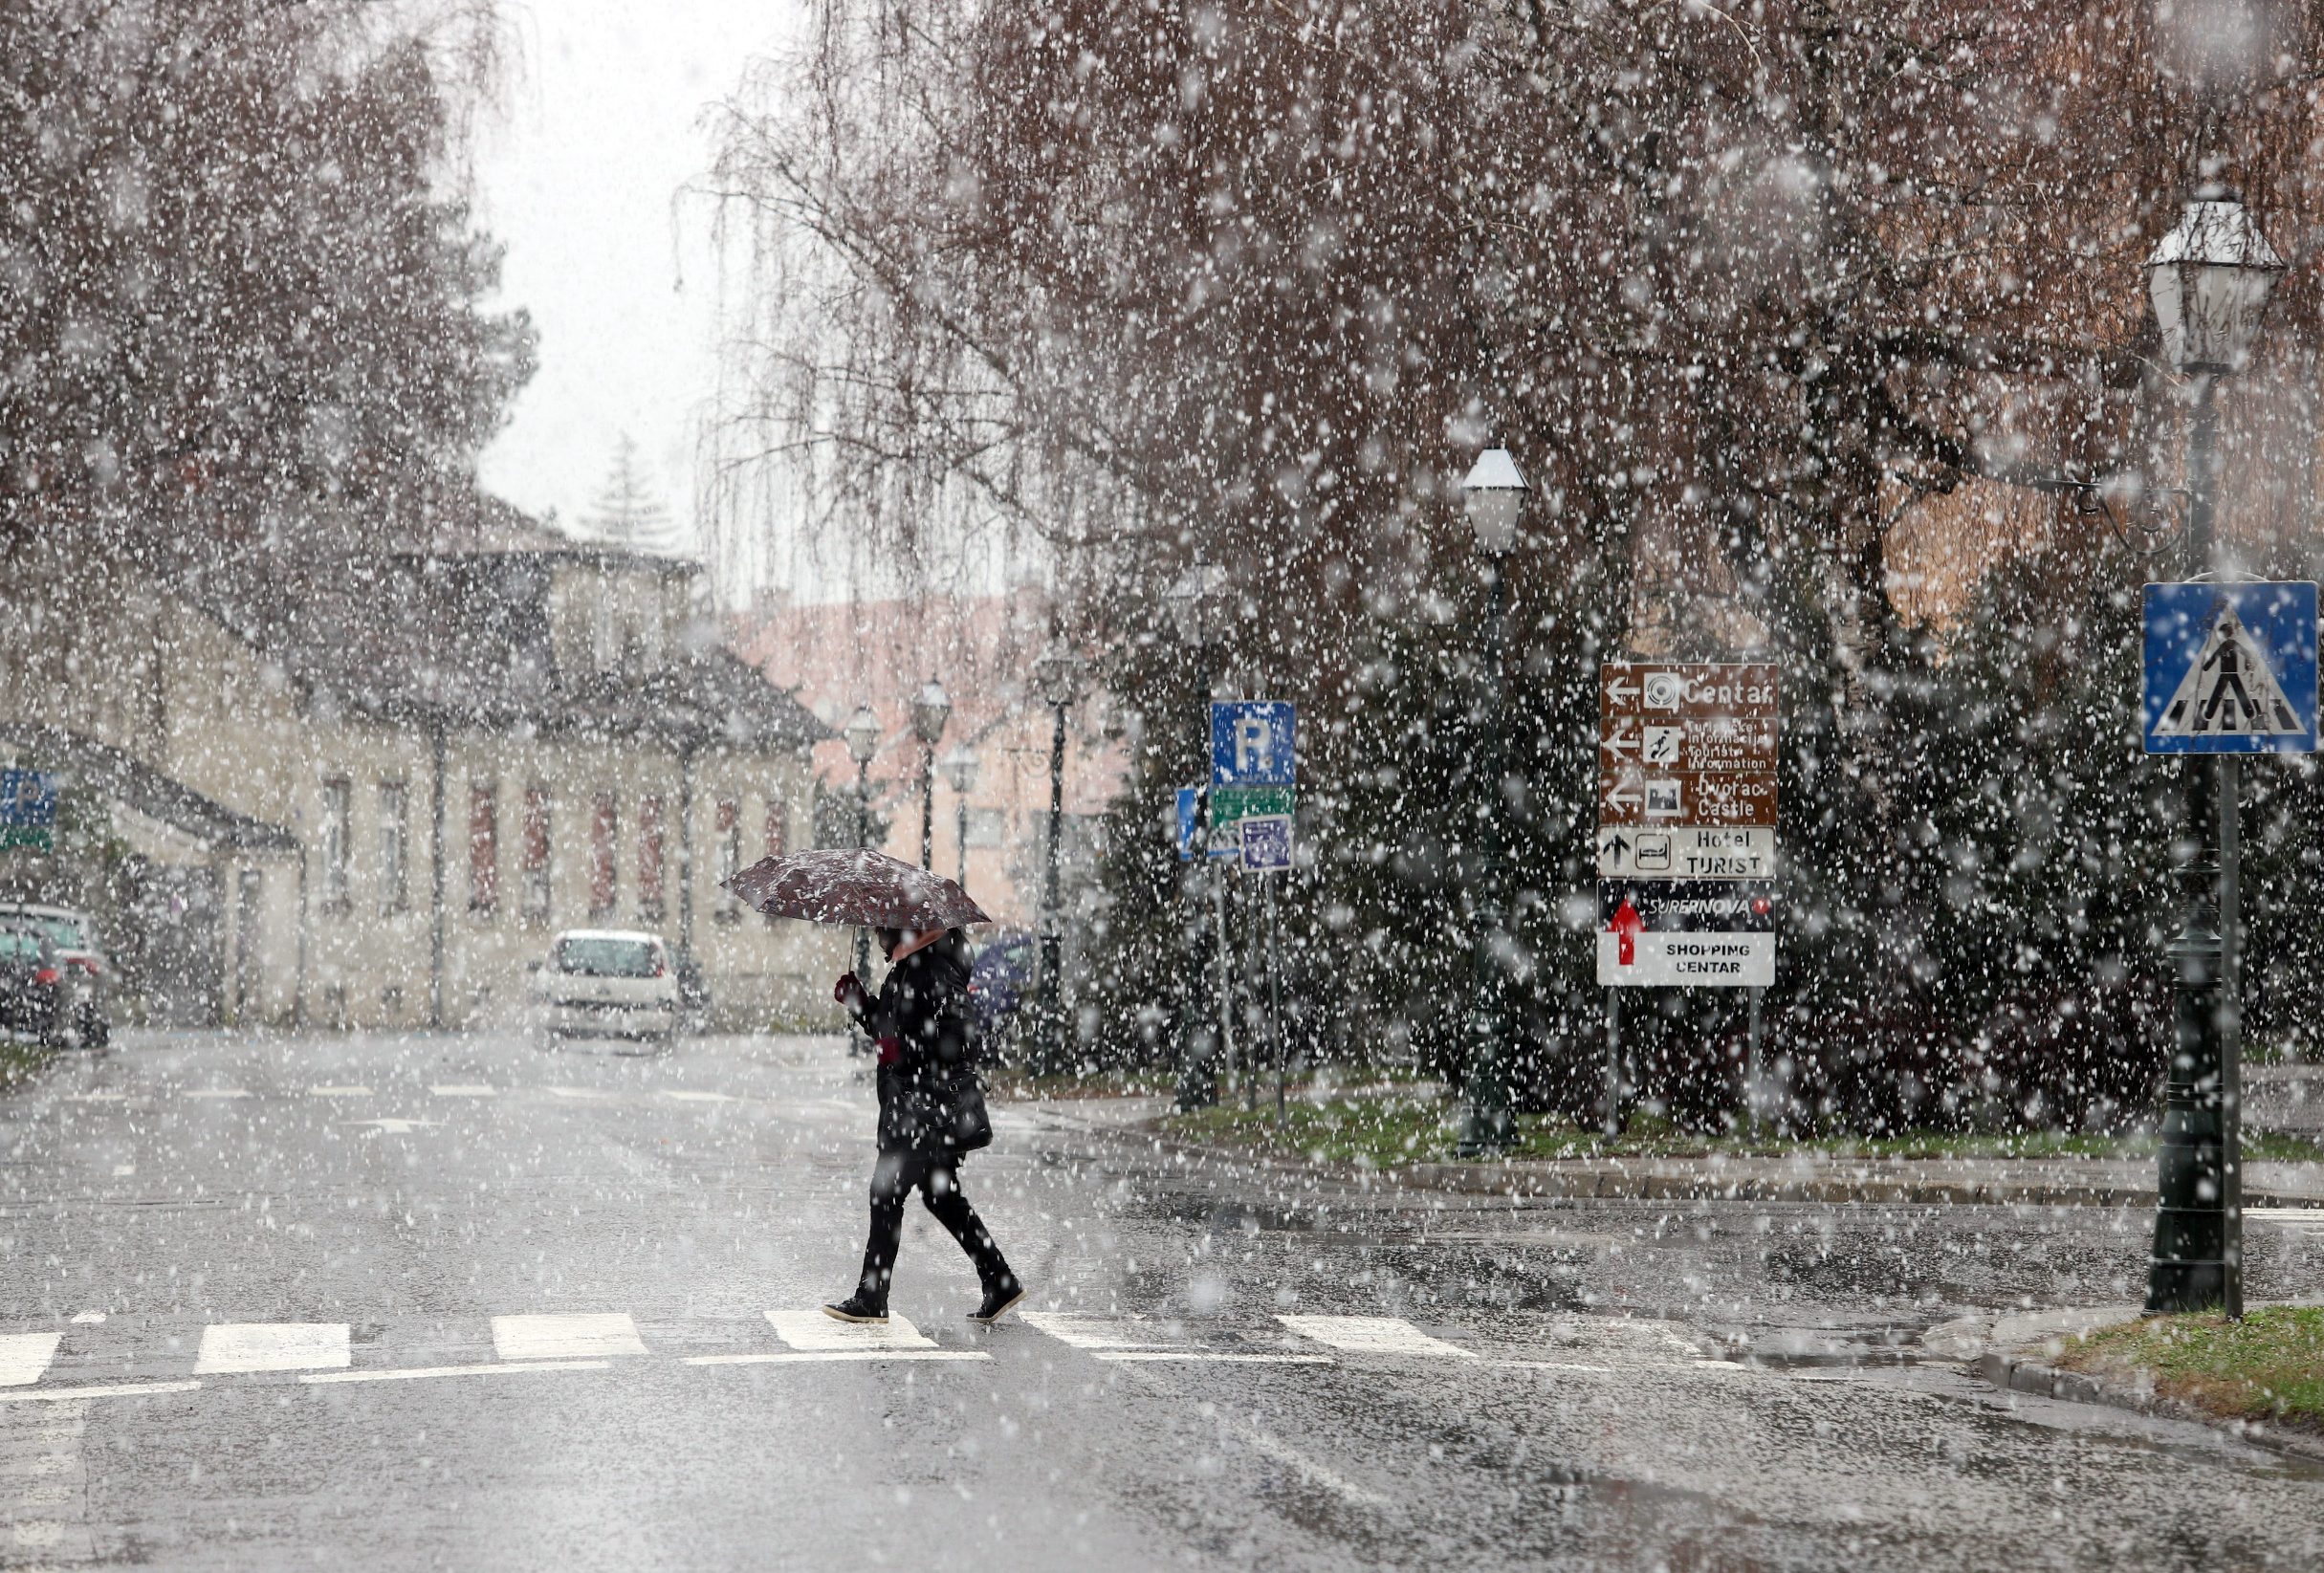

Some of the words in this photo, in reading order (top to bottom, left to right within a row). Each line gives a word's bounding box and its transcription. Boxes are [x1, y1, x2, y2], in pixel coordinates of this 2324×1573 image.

[1684, 679, 1773, 705] Centar
[1699, 779, 1761, 797] Dvorac
[1699, 801, 1754, 817] Castle
[1698, 831, 1750, 848] Hotel
[1687, 857, 1761, 874] TURIST
[1648, 899, 1750, 914] SUPERNOVA
[1667, 944, 1750, 956] SHOPPING
[1677, 962, 1741, 973] CENTAR
